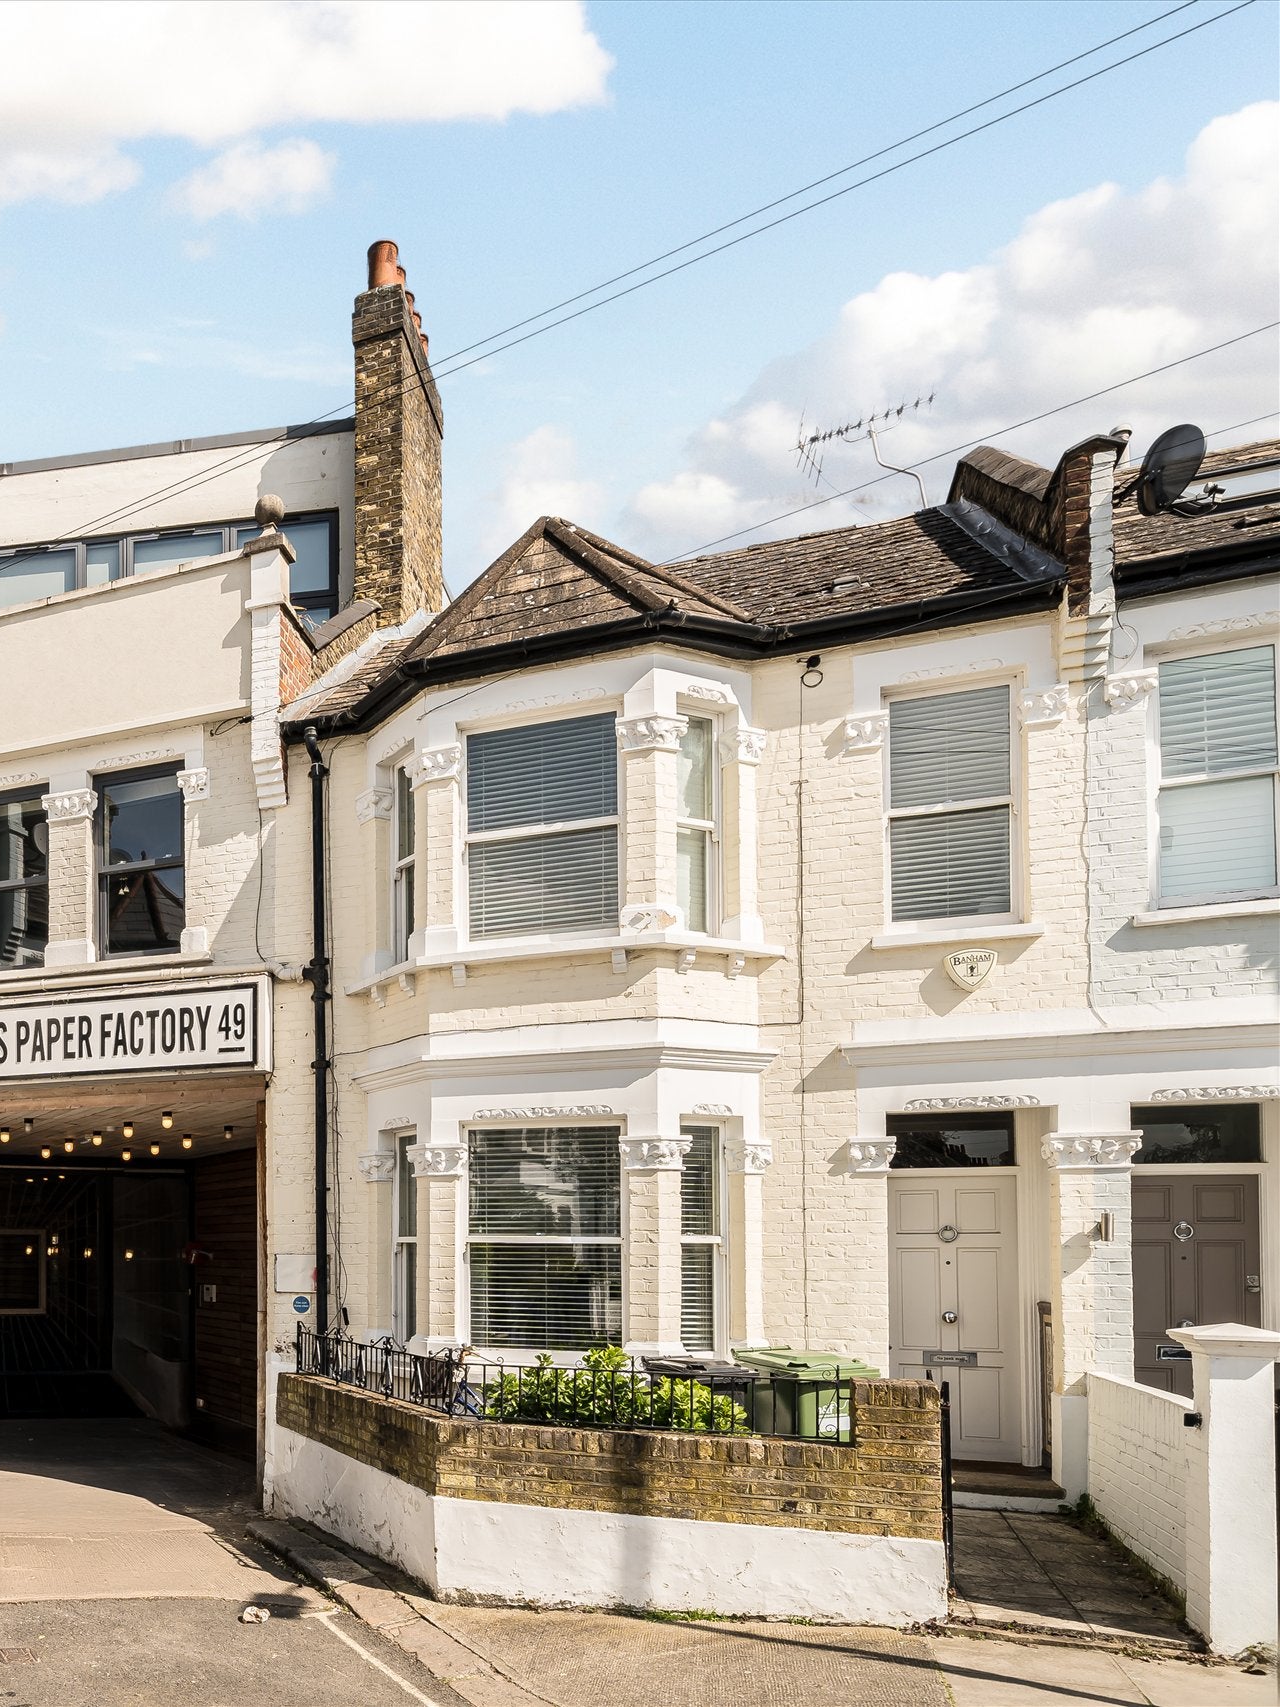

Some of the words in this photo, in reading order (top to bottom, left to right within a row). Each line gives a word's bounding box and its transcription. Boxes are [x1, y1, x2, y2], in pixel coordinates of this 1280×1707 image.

[953, 954, 991, 966] BANHAM
[16, 1015, 93, 1063] PAPER
[99, 1005, 212, 1058] FACTORY
[217, 1003, 245, 1041] 49
